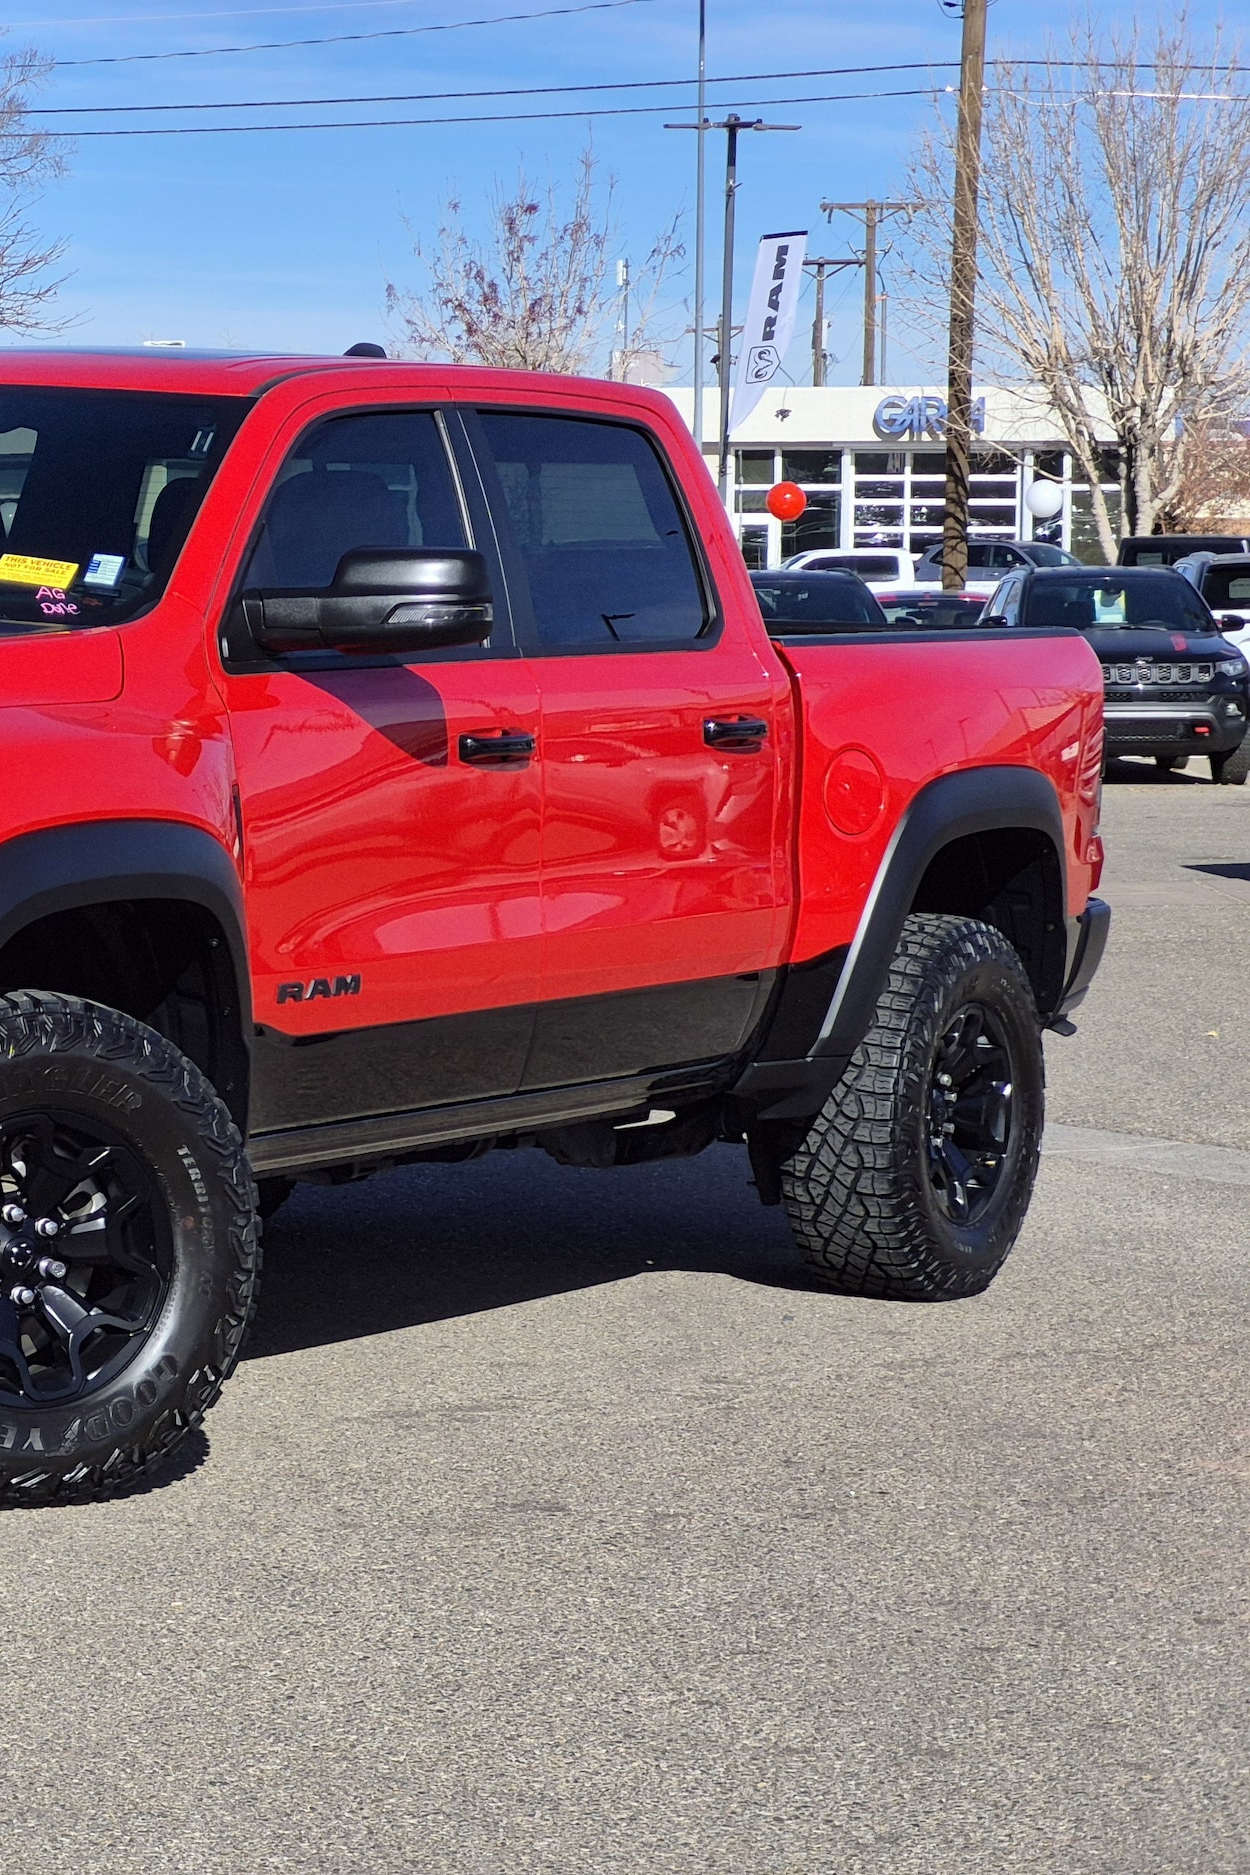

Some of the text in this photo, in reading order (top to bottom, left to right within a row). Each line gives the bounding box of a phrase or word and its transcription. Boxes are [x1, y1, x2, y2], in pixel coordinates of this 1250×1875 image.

[762, 244, 789, 342] RAM
[873, 394, 986, 433] GARA
[5, 556, 74, 571] THIS VEHICLE
[276, 973, 362, 1005] RAM
